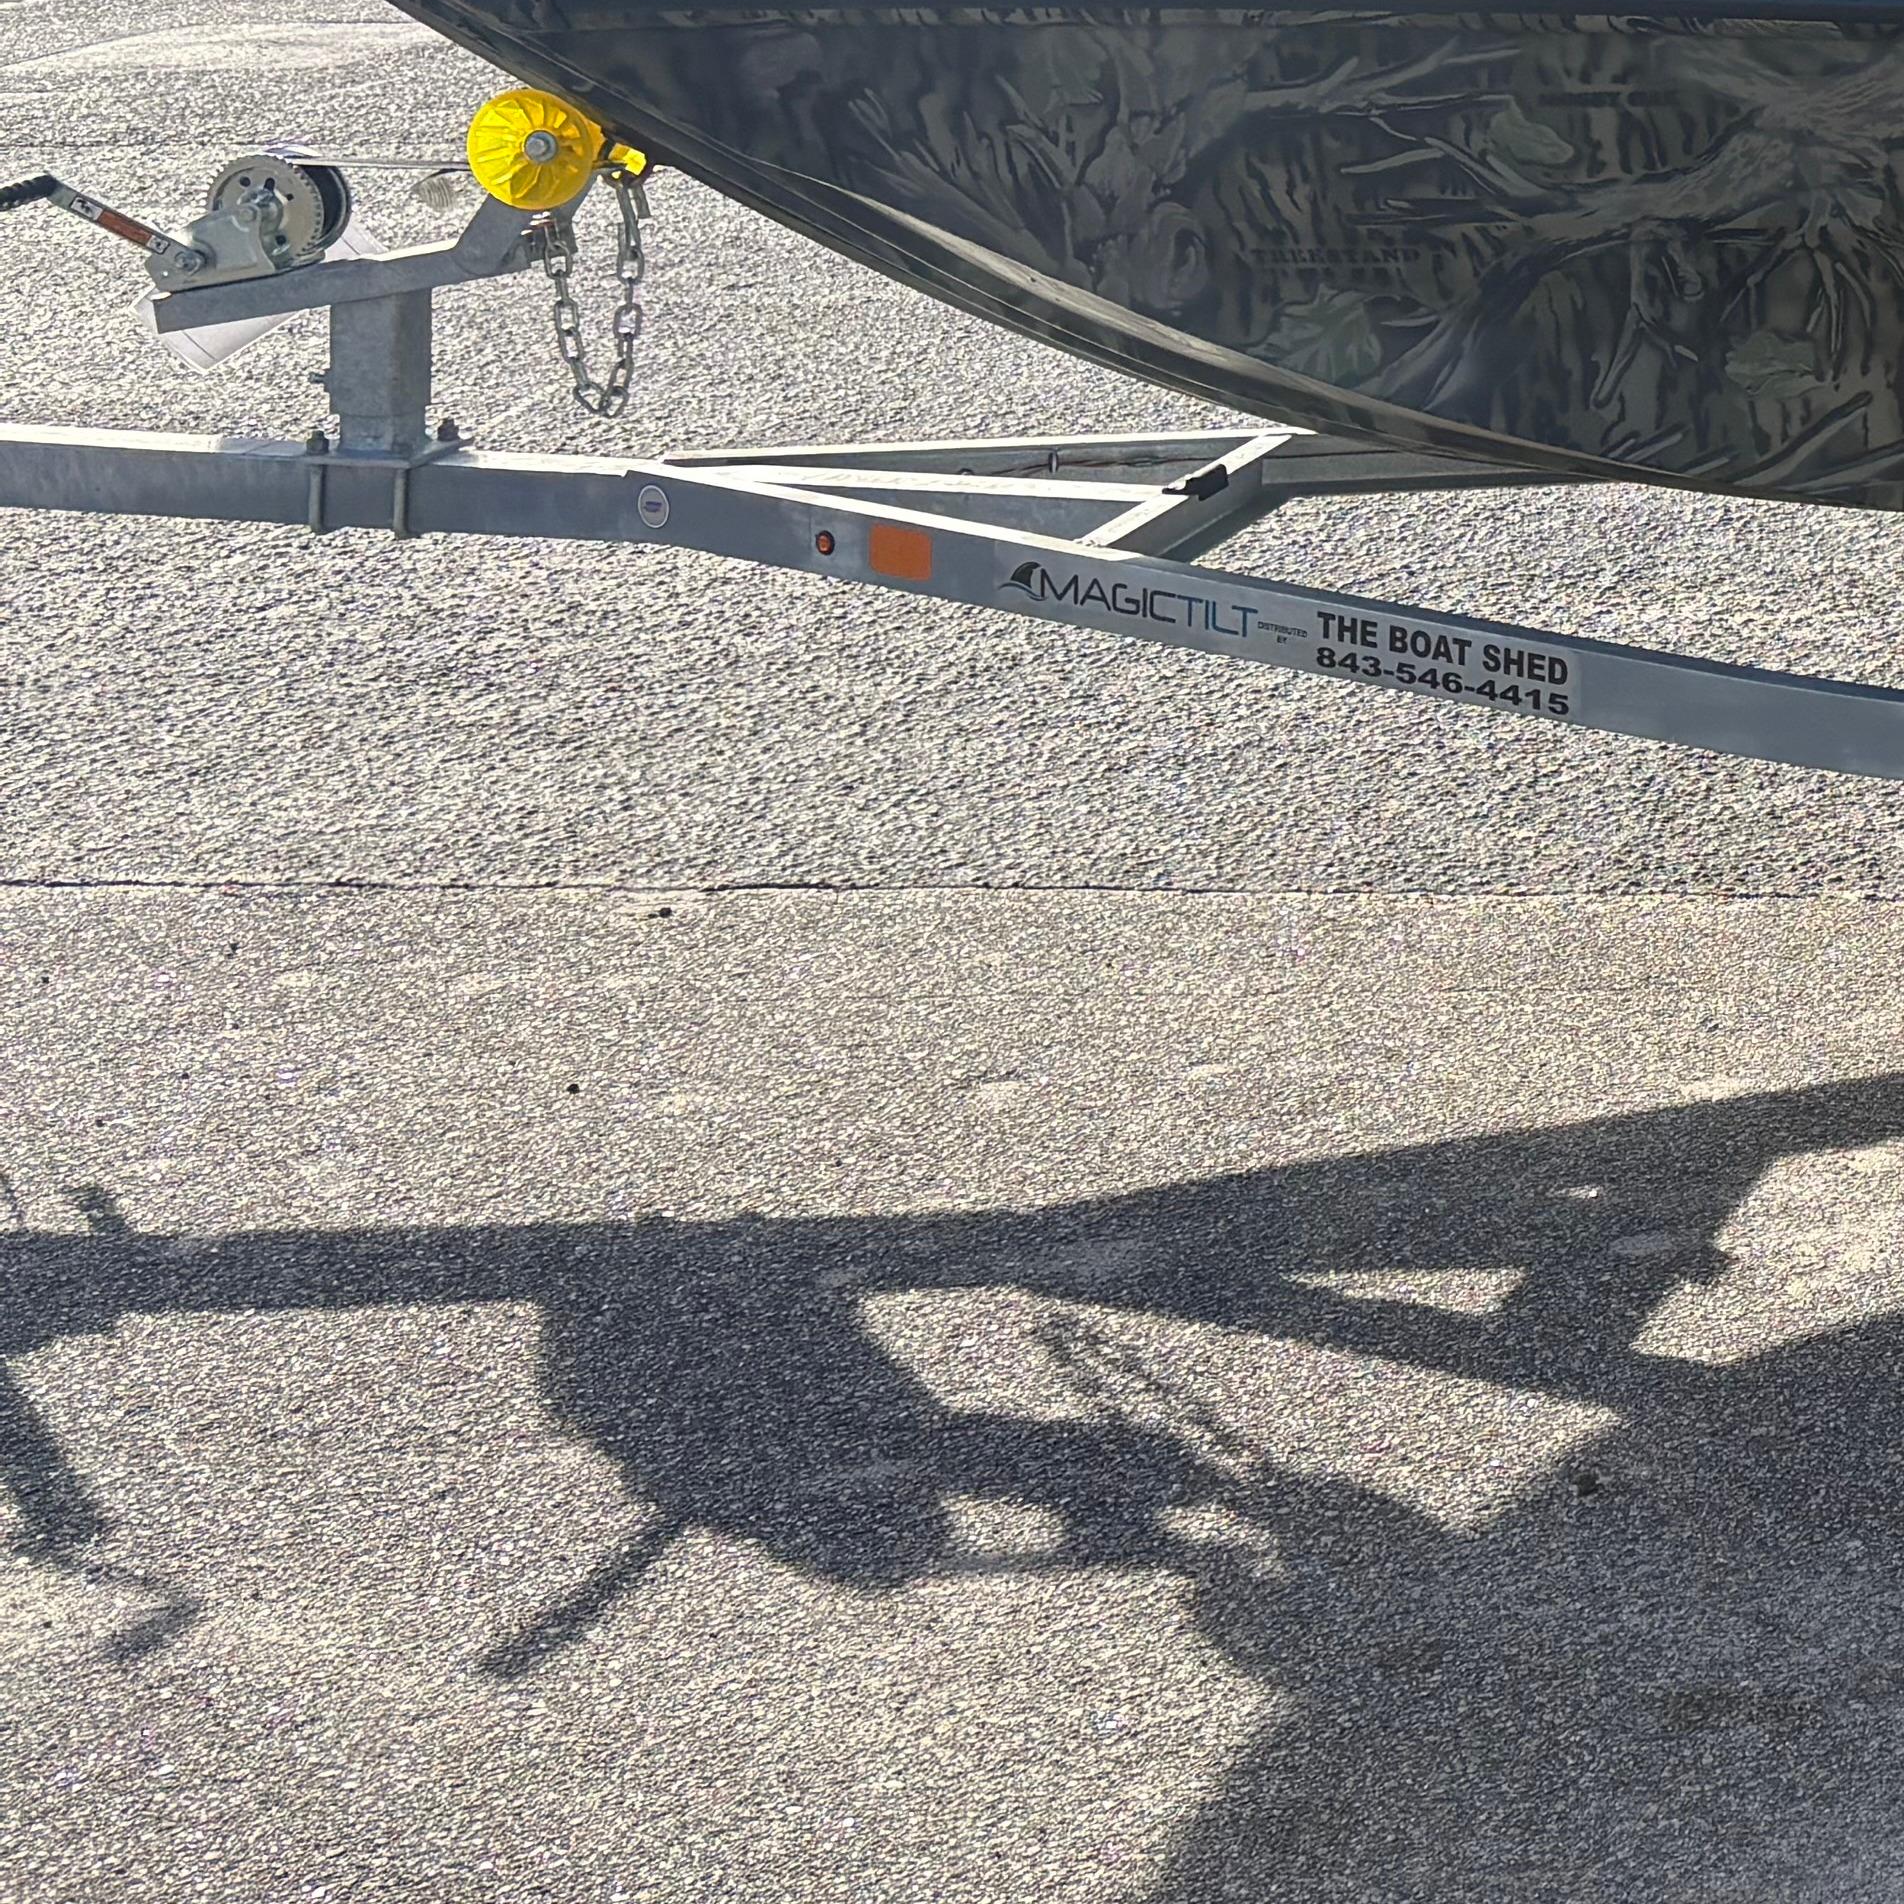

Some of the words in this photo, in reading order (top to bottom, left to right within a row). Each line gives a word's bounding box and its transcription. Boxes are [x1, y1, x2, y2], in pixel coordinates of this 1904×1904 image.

[1040, 567, 1259, 638] MAGICTILT
[1257, 620, 1308, 638] DISTRIBUTED
[1315, 646, 1570, 716] 843-546-4415
[1316, 610, 1379, 649] THE
[1388, 624, 1473, 667] BOAT
[1482, 643, 1569, 686] SHED
